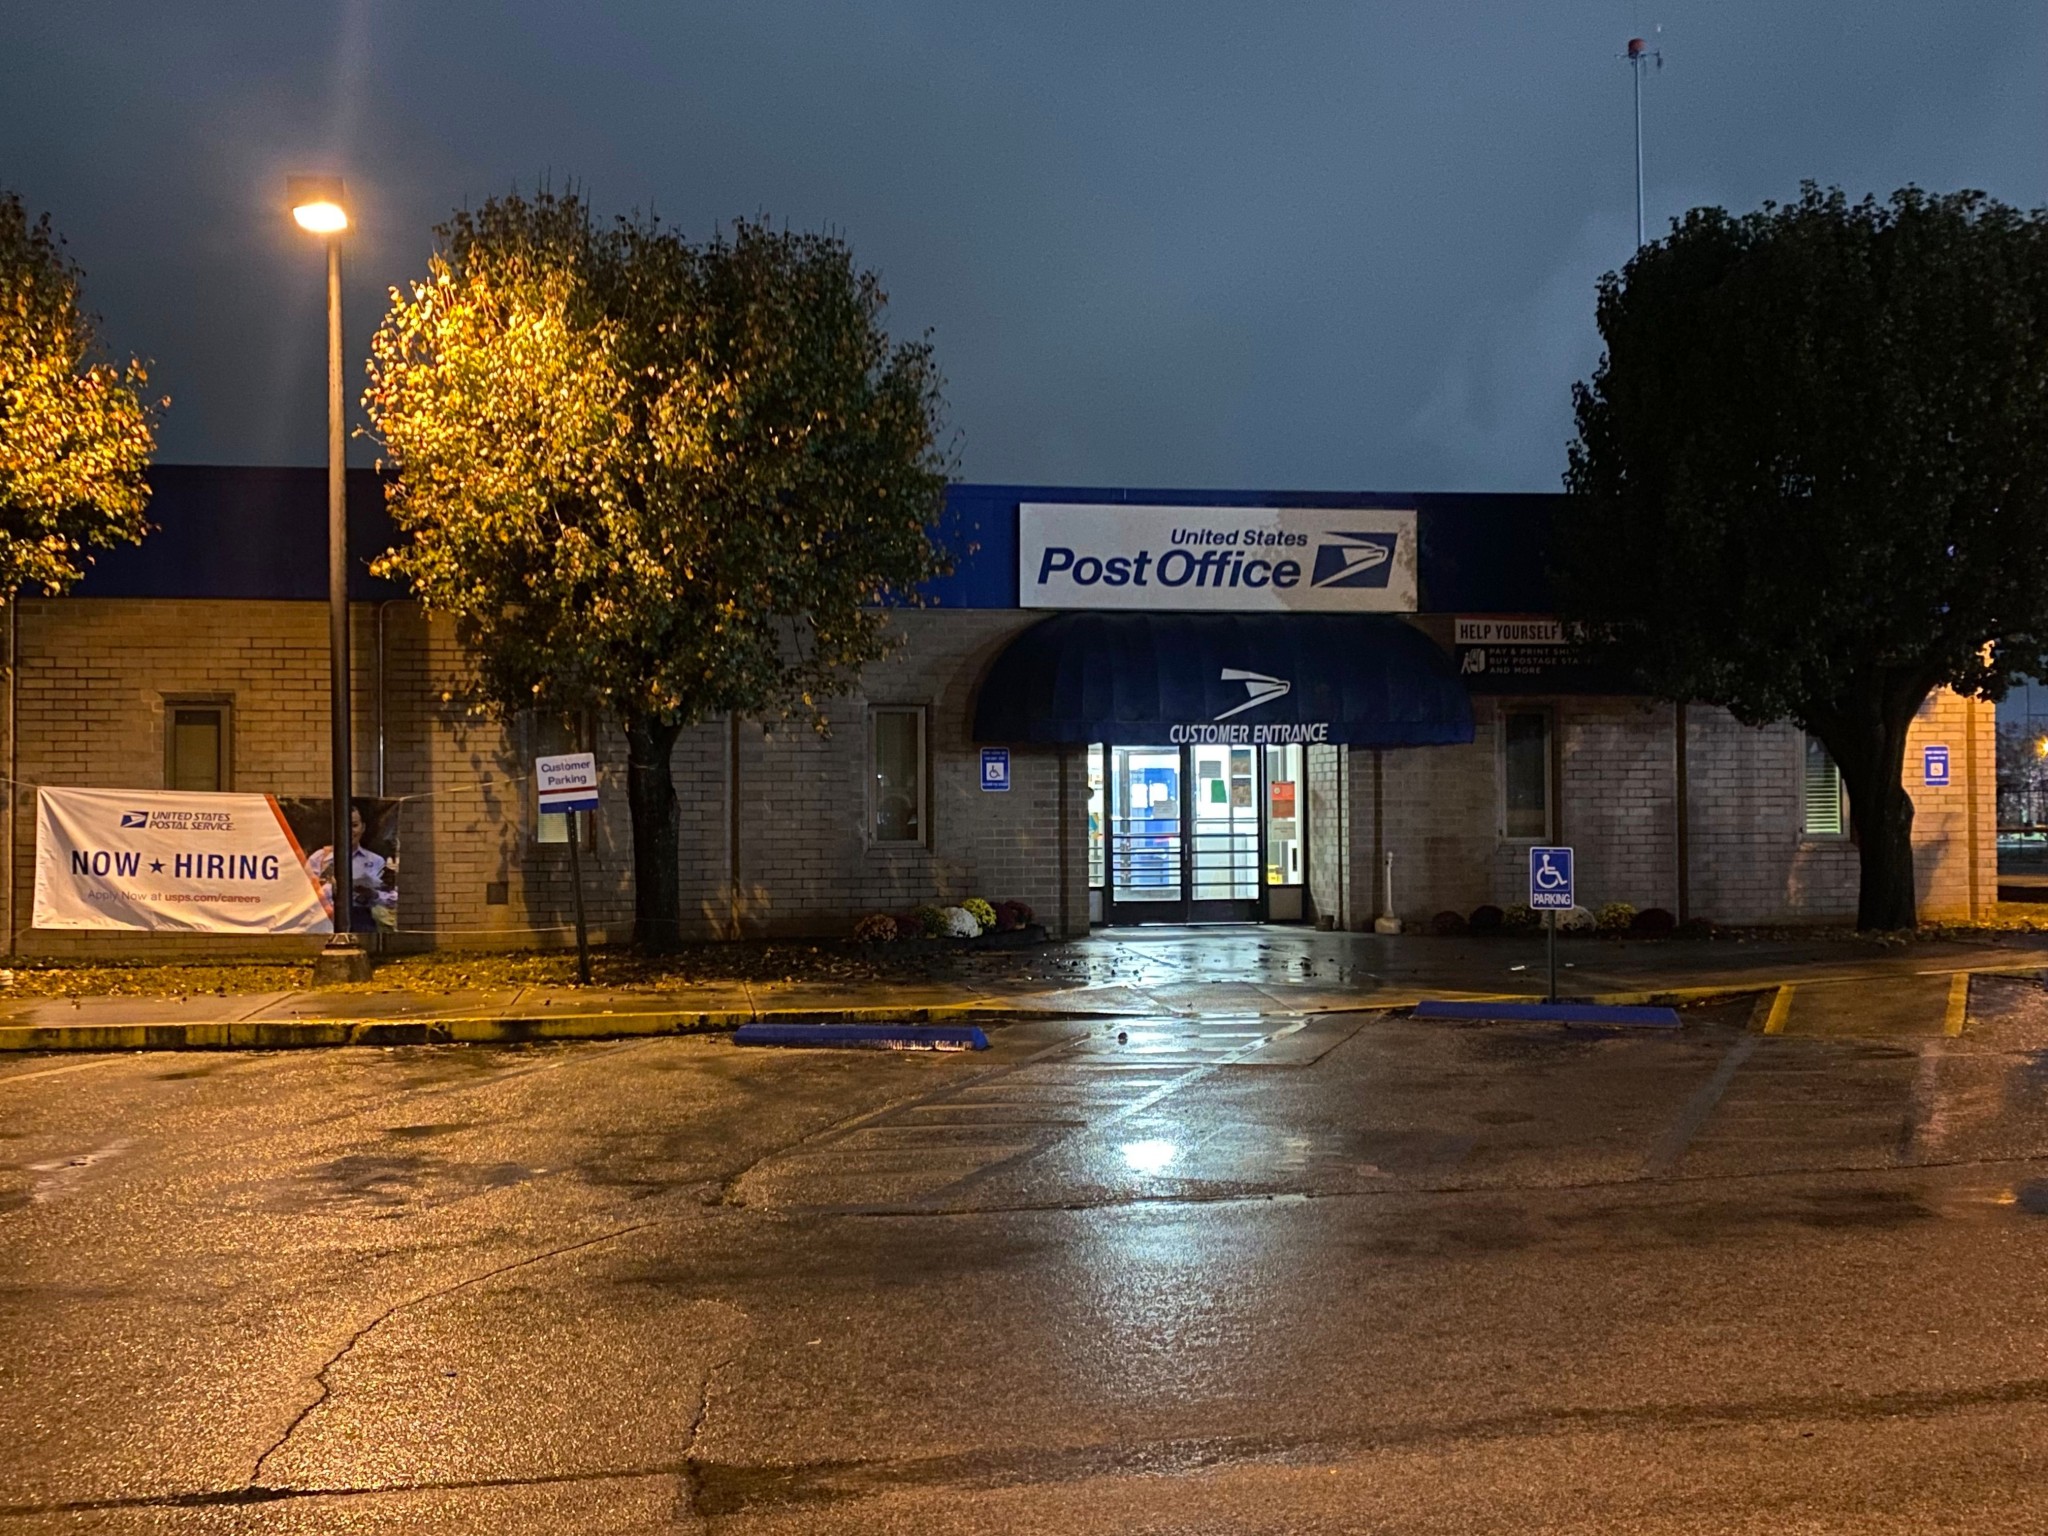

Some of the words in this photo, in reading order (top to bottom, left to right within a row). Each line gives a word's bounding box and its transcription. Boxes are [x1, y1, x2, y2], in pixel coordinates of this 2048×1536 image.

[1171, 529, 1238, 546] United
[1243, 530, 1308, 547] States
[1037, 547, 1151, 586] Post
[1156, 549, 1301, 588] Office
[1460, 624, 1491, 639] HELP
[1496, 625, 1558, 640] YOURSELF
[1489, 657, 1509, 665] BUY
[1513, 657, 1558, 665] POSTAGE
[1170, 724, 1249, 743] CUSTOMER
[1253, 723, 1329, 743] ENTRANCE
[541, 761, 591, 773] Customer
[547, 775, 587, 786] Parking
[151, 811, 192, 820] UNITED
[193, 812, 231, 822] STATES
[149, 820, 188, 830] POSTAL
[71, 850, 141, 877] NOW
[174, 853, 279, 880] HIRING
[88, 889, 118, 902] Apply
[121, 891, 147, 901] Now
[150, 892, 162, 901] at
[165, 893, 261, 904] usps.com/careers
[1533, 893, 1570, 905] PARKING
